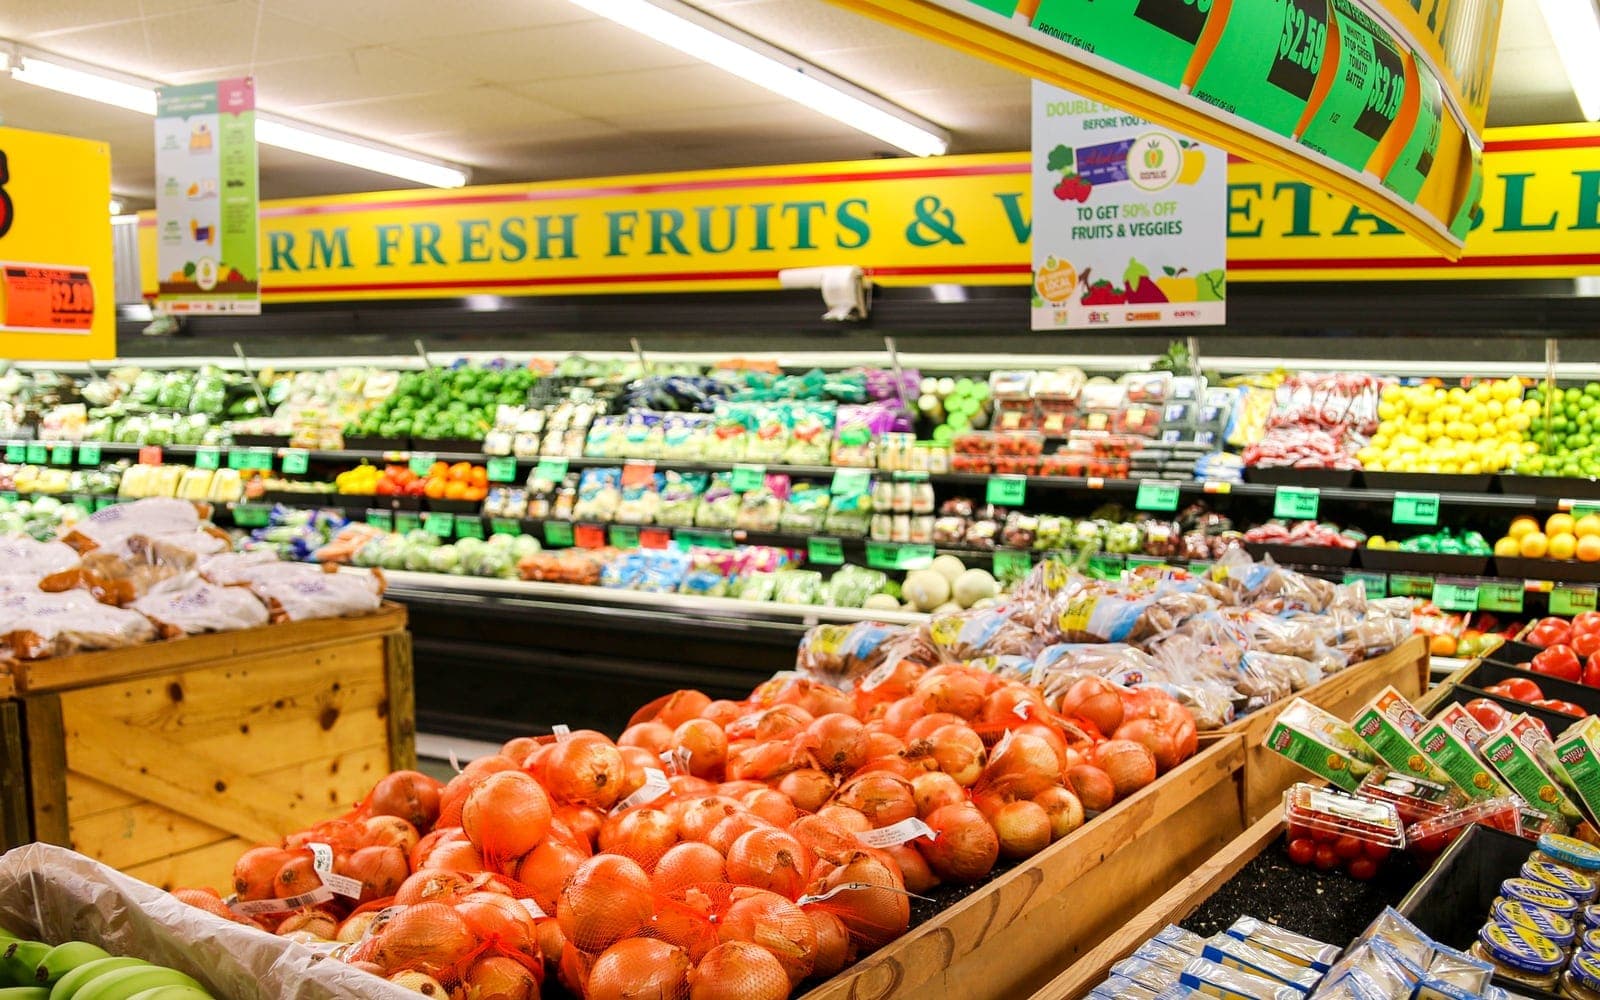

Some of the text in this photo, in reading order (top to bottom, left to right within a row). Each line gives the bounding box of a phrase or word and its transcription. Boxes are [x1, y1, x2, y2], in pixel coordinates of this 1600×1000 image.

[1038, 22, 1096, 54] PRODUCT OF USA
[1280, 0, 1326, 75] $2.59
[1344, 21, 1367, 47] WHISTLE
[1344, 35, 1372, 64] STOP GREEN
[1349, 54, 1368, 76] TOMATO
[1345, 69, 1365, 91] BATTER
[1367, 58, 1405, 121] $3.19
[1046, 99, 1098, 117] DOUBLE
[1196, 90, 1220, 109] PRODUCT
[1083, 117, 1118, 130] BEFORE
[1120, 116, 1140, 127] YOU
[1077, 201, 1178, 220] TO GET 50% OFF
[259, 227, 355, 273] RM
[374, 213, 579, 267] FRESH
[603, 198, 872, 258] FRUITS
[905, 194, 966, 247] &
[1072, 220, 1183, 240] FRUITS & VEGGIES
